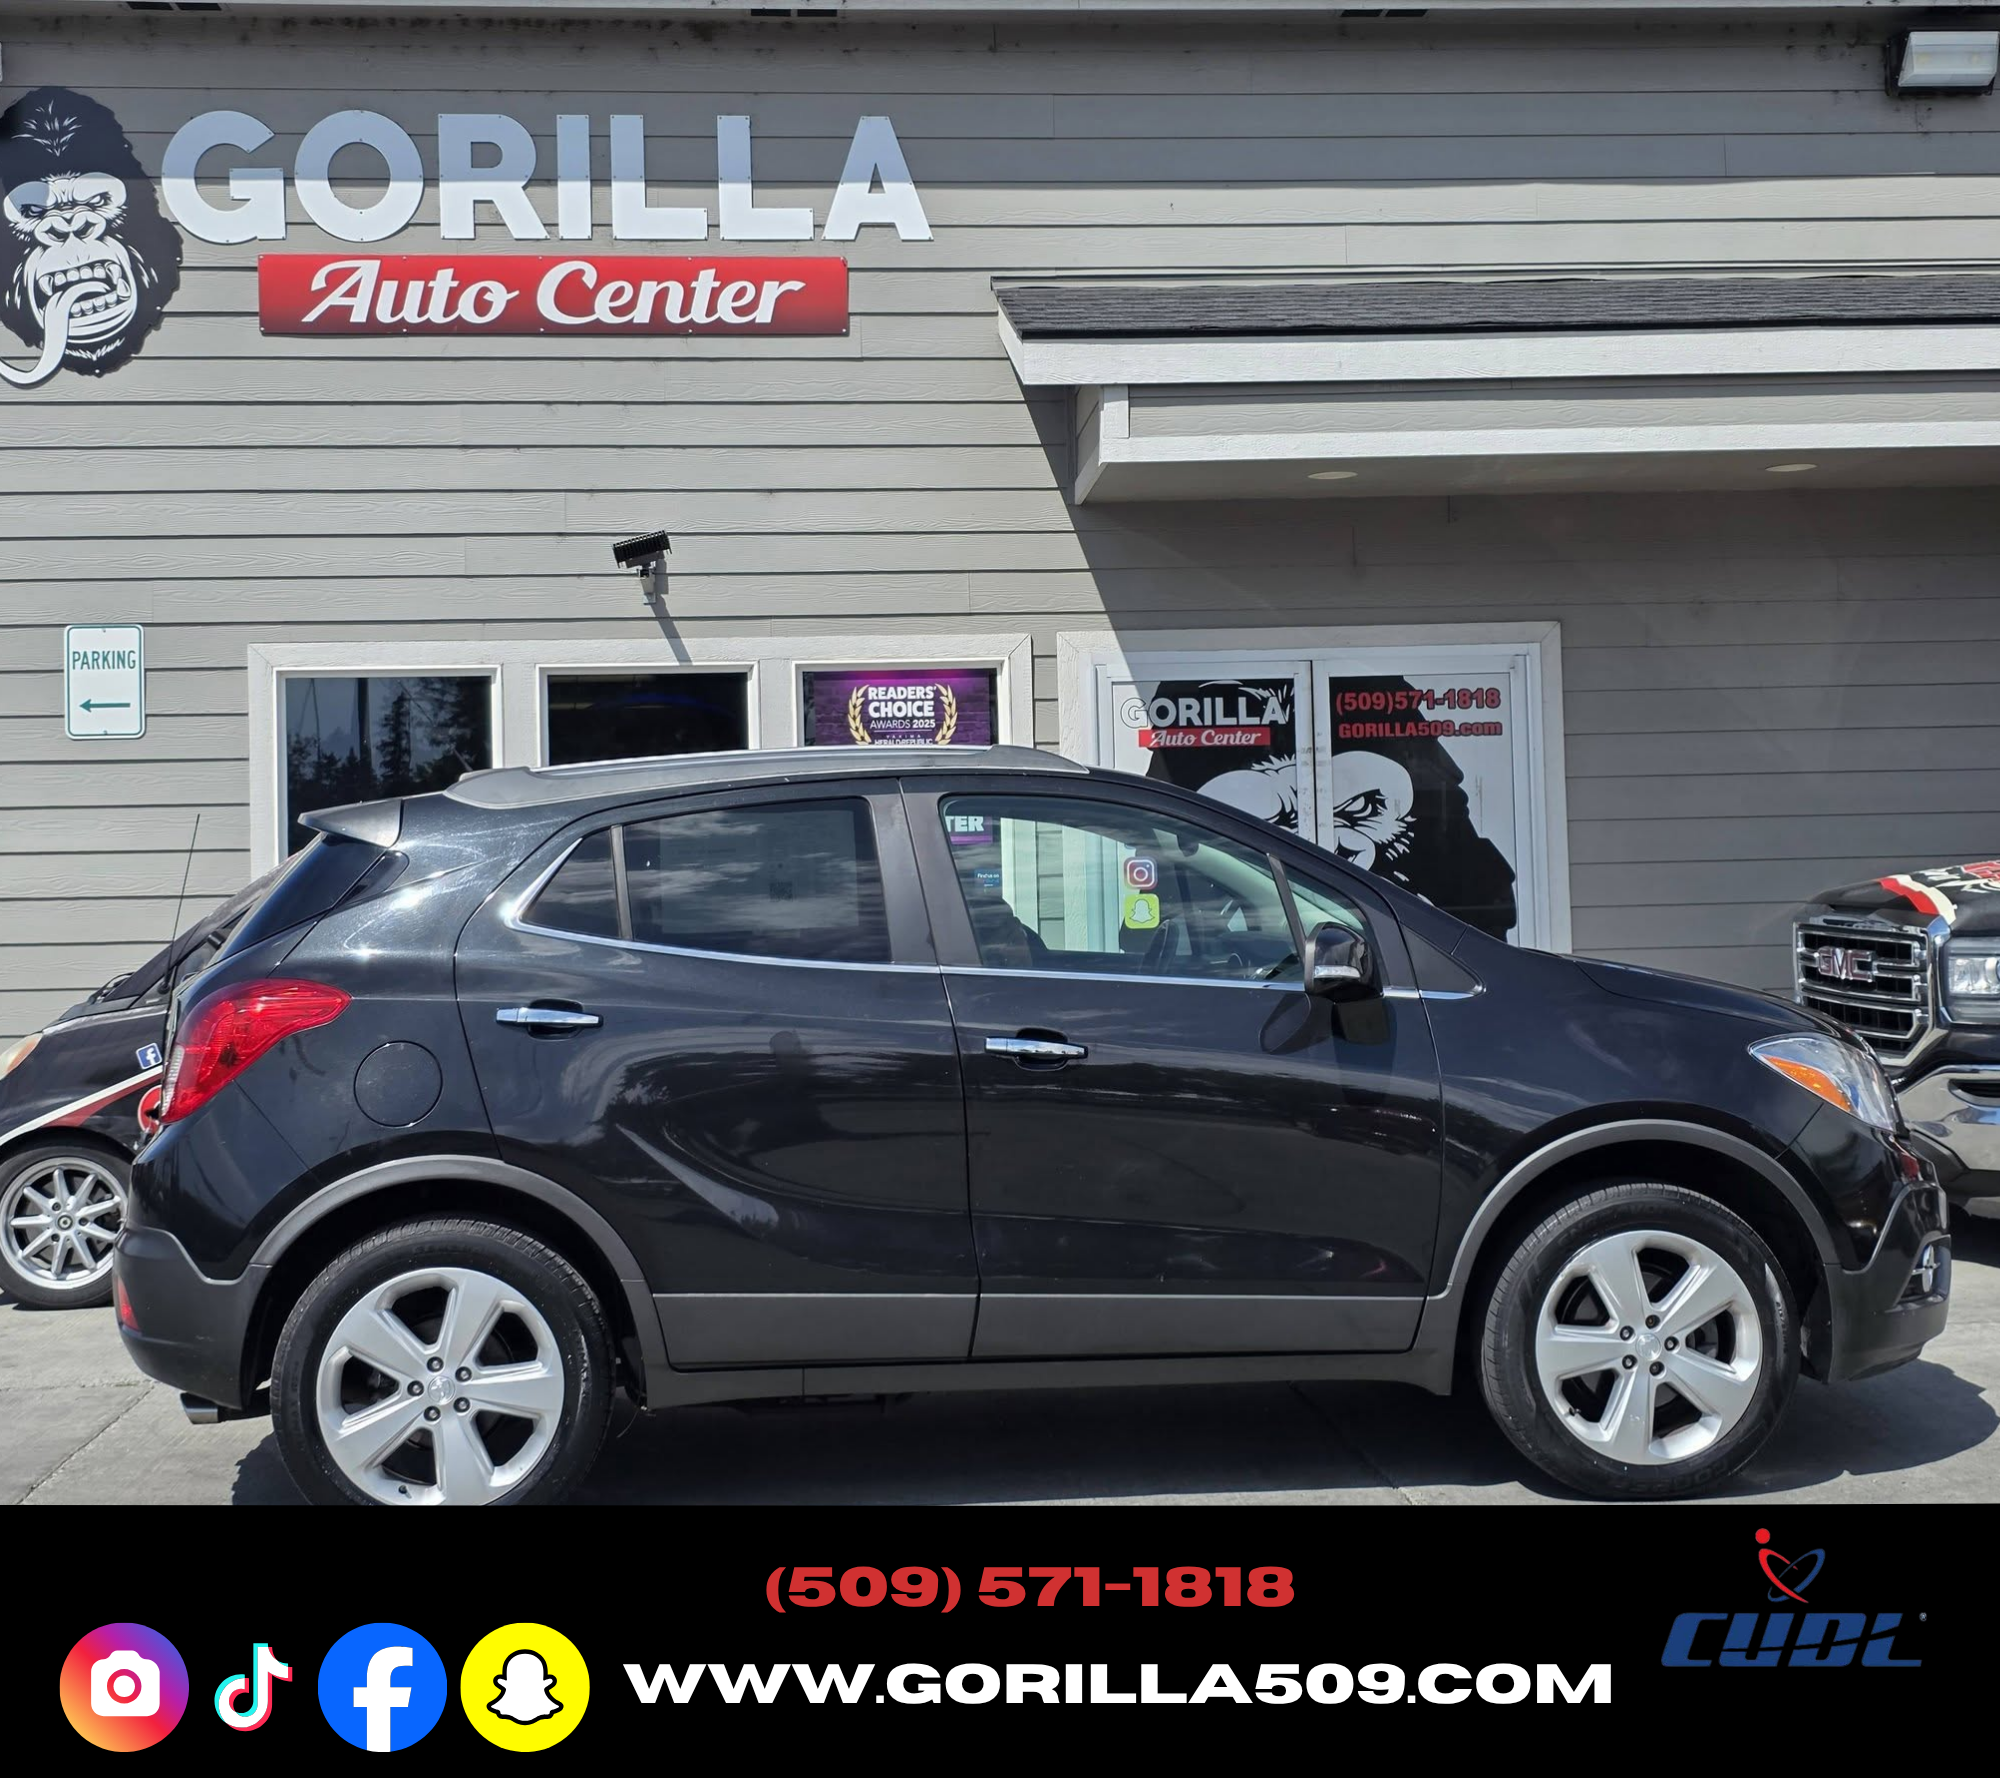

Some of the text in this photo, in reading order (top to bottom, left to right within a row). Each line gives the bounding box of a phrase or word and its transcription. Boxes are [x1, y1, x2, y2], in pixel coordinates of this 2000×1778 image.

[161, 110, 934, 244] GORILLA
[302, 259, 805, 325] Auto Center
[72, 650, 136, 670] PARKING
[868, 686, 937, 700] READERS'
[1335, 687, 1501, 716] (509)571-1818
[868, 701, 935, 718] CHOICE
[1120, 696, 1287, 729] GORILLA
[869, 719, 936, 729] AWARDS 2025
[1338, 720, 1503, 739] GORILLA509.com
[1150, 729, 1262, 747] Auto Center
[1817, 945, 1872, 983] GMC
